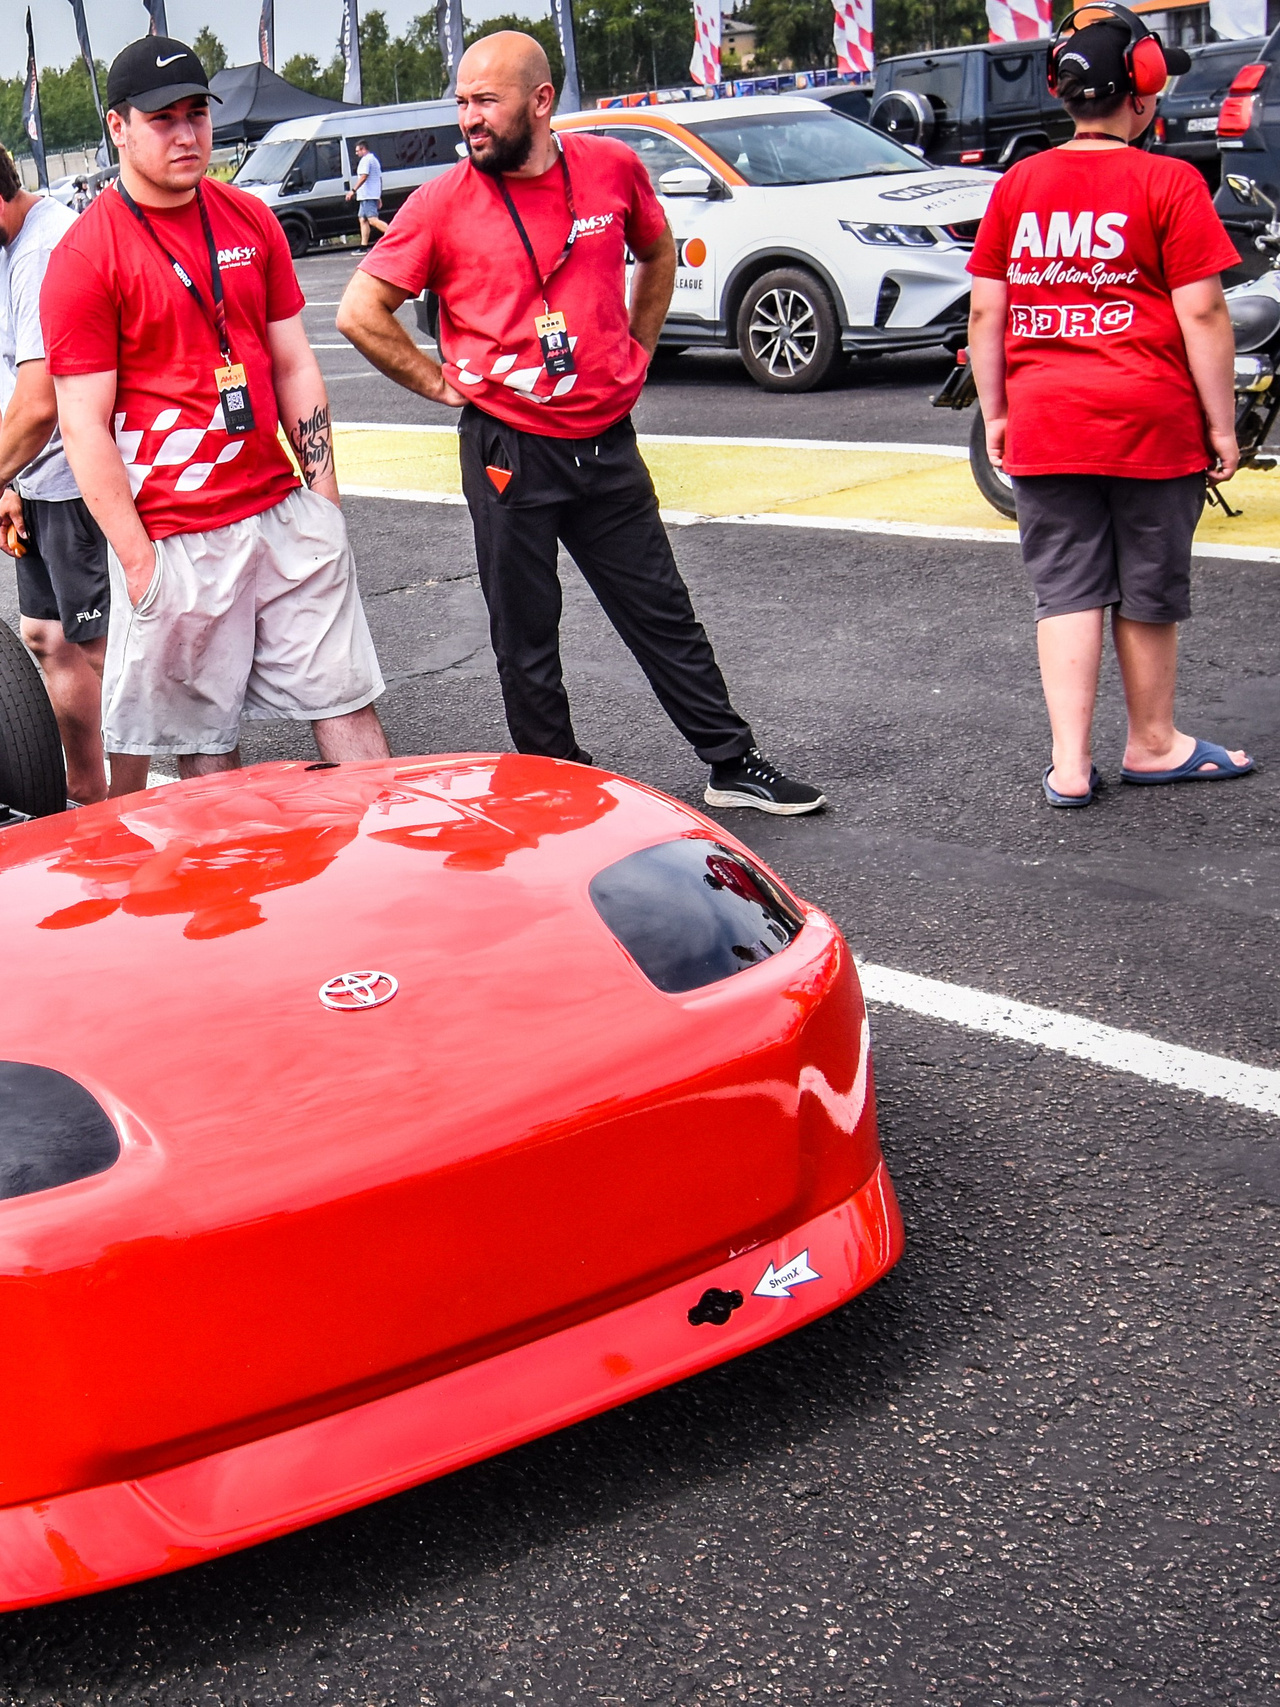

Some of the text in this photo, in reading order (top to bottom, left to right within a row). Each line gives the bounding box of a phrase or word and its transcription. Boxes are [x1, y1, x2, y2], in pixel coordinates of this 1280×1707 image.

[1010, 211, 1129, 260] AMS
[675, 278, 703, 290] LEAGUE
[1009, 300, 1134, 339] RDRC
[75, 608, 103, 624] FILA
[768, 1266, 800, 1289] ShonX
